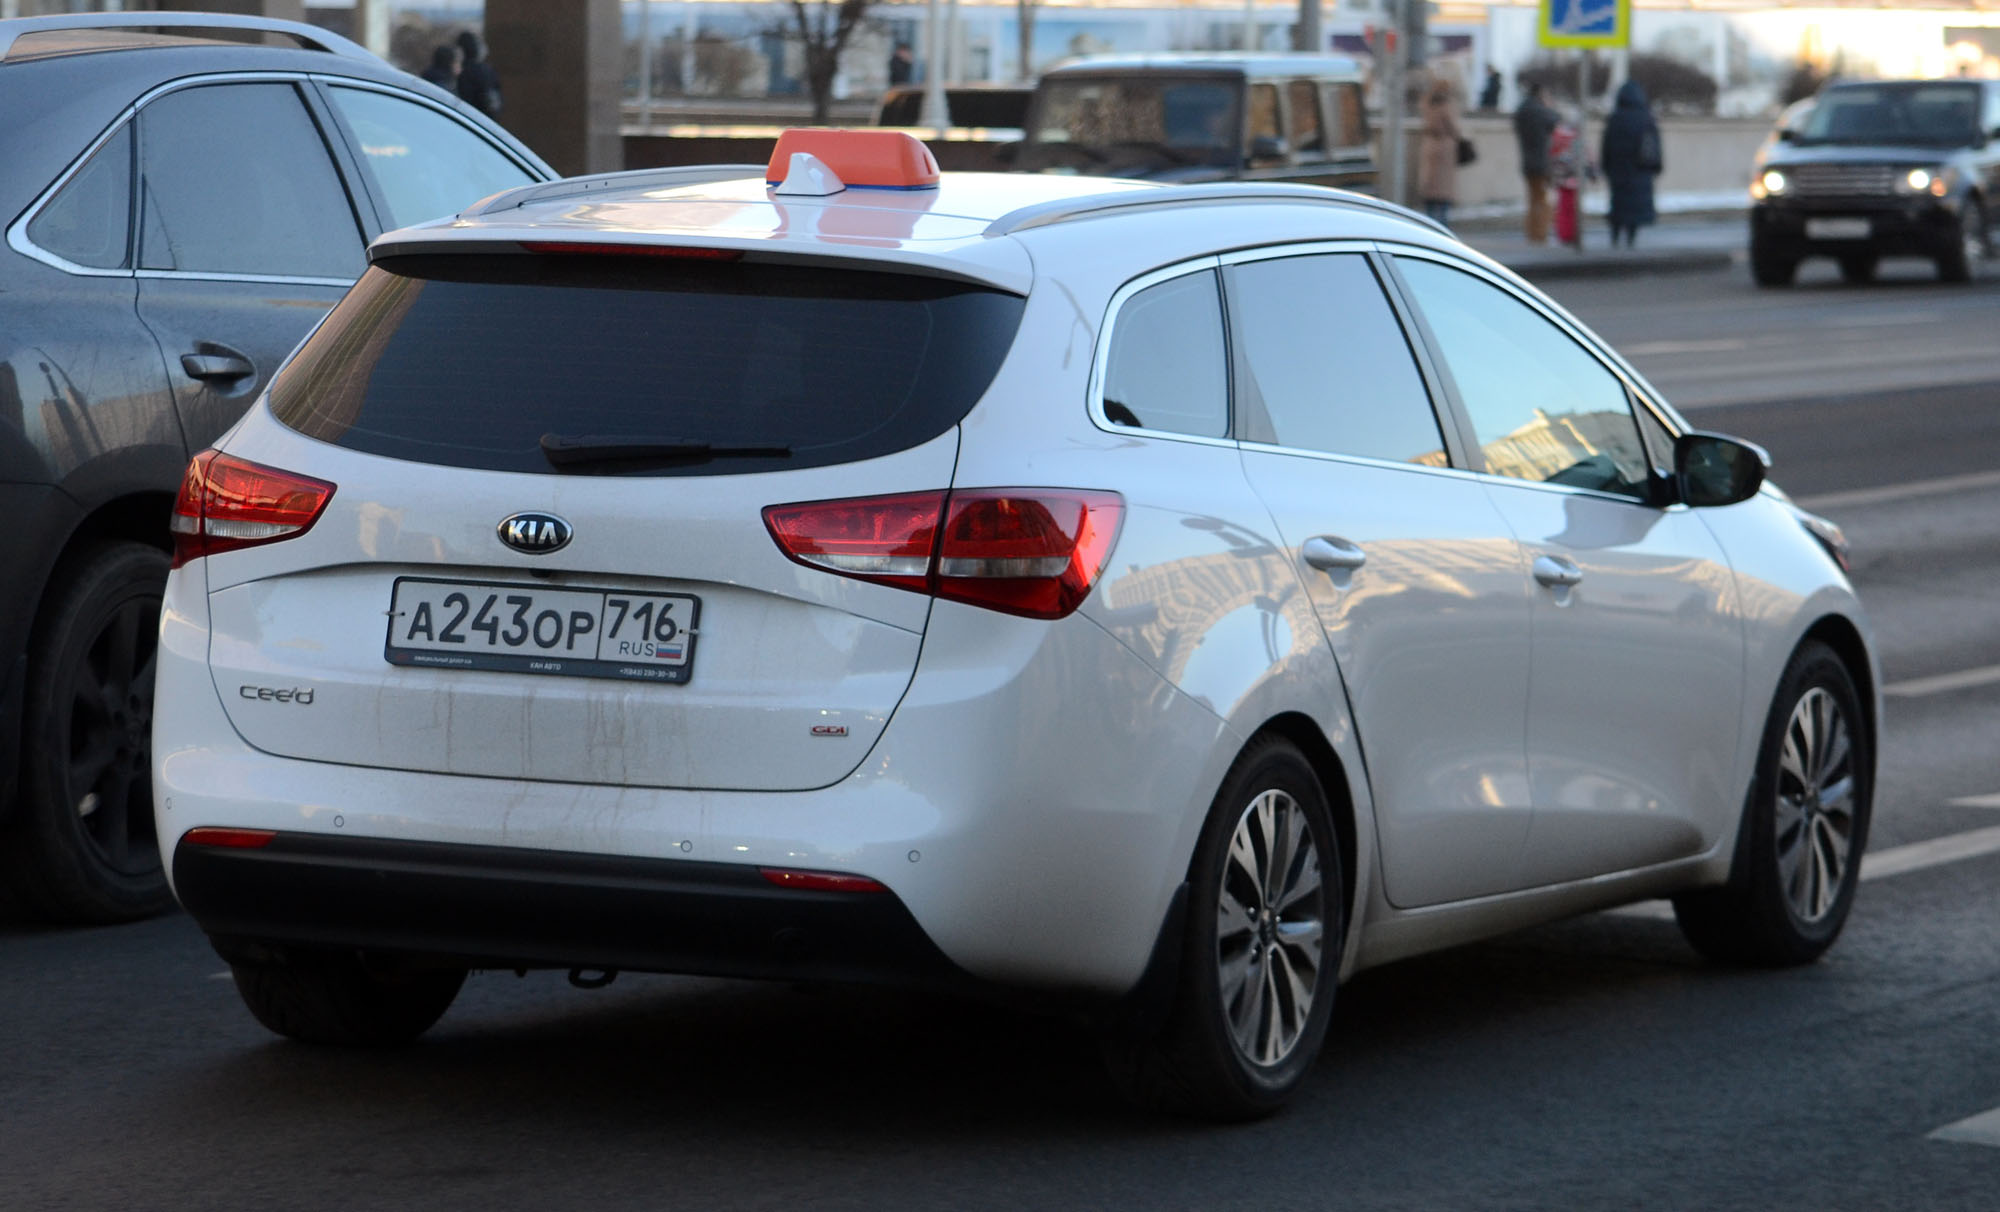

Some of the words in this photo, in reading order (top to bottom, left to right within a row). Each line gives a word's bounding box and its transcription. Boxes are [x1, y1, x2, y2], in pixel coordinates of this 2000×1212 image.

[508, 519, 559, 544] KIA
[607, 599, 678, 643] 716
[619, 642, 654, 657] RUS
